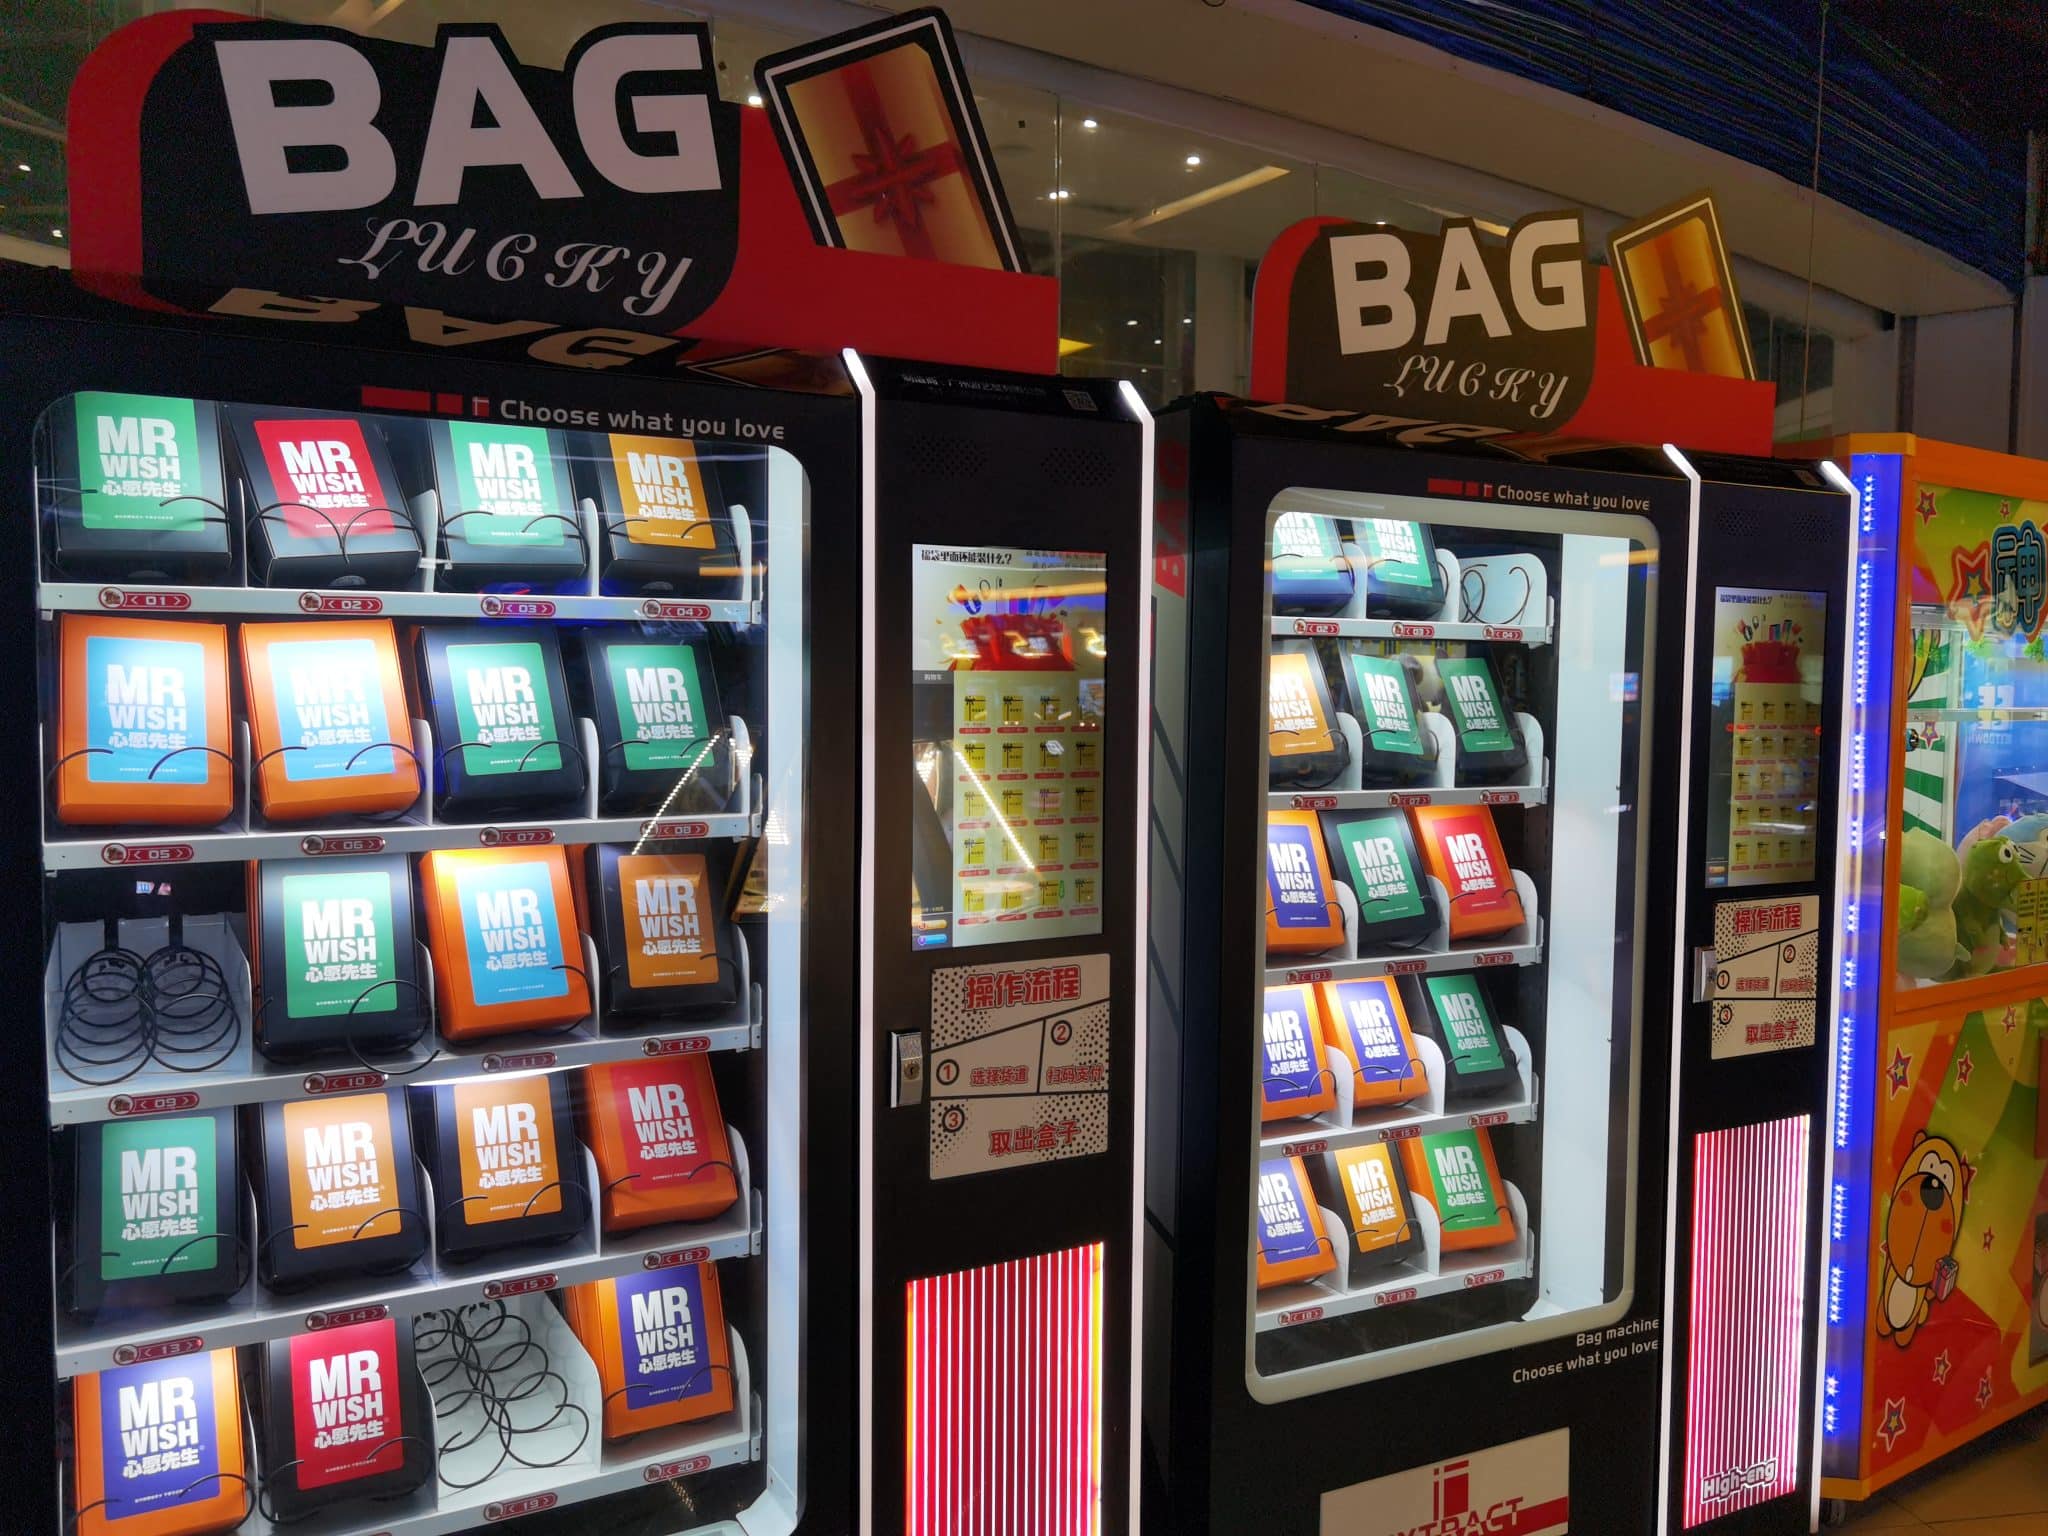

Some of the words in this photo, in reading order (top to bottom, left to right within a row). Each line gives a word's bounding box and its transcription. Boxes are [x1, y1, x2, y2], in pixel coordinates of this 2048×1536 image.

[213, 33, 722, 215] BAG
[338, 218, 690, 316] LUCKY
[1329, 218, 1587, 355] BAG
[1383, 354, 1568, 418] LUCKY
[500, 399, 600, 426] Choose
[608, 409, 673, 432] what
[682, 420, 726, 438] you
[735, 418, 785, 440] love
[97, 416, 177, 456] MR
[99, 455, 181, 479] WISH
[279, 441, 357, 474] MR
[469, 443, 537, 479] MR
[627, 453, 689, 487] MR
[290, 473, 364, 493] WISH
[475, 477, 541, 499] WISH
[633, 485, 692, 506] WISH
[1498, 485, 1549, 502] Choose
[1554, 491, 1589, 505] what
[1594, 496, 1617, 510] you
[1622, 496, 1649, 511] love
[1277, 527, 1320, 544] WISH
[1377, 532, 1417, 552] WISH
[146, 597, 165, 605] 01
[341, 600, 361, 609] 02
[519, 604, 536, 613] 03
[677, 608, 693, 616] 04
[107, 664, 186, 705] MR
[468, 667, 534, 704] MR
[626, 667, 688, 703] MR
[1364, 672, 1403, 703] MR
[1451, 675, 1490, 701] MR
[109, 705, 187, 730] WISH
[296, 705, 369, 728] WISH
[473, 704, 537, 726] WISH
[632, 703, 692, 723] WISH
[1270, 701, 1313, 718] WISH
[1372, 700, 1407, 719] WISH
[1460, 701, 1495, 718] WISH
[517, 833, 535, 841] 07
[1446, 833, 1487, 863] MR
[148, 850, 170, 858] 05
[1269, 843, 1310, 872] MR
[1353, 837, 1400, 869] MR
[1277, 872, 1314, 890] WISH
[1362, 864, 1405, 882] WISH
[1454, 860, 1492, 879] WISH
[476, 888, 542, 929] MR
[635, 878, 697, 915] MR
[302, 899, 375, 939] MR
[640, 914, 700, 938] WISH
[1735, 903, 1802, 936] 操作流程
[304, 938, 376, 963] WISH
[481, 927, 545, 953] WISH
[964, 965, 1081, 1011] 操作流程
[1351, 999, 1392, 1028] MR
[1441, 993, 1480, 1020] MR
[1263, 1009, 1303, 1043] MR
[1357, 1026, 1396, 1046] WISH
[1450, 1019, 1485, 1037] WISH
[1266, 1039, 1307, 1061] WISH
[347, 1077, 365, 1086] 10
[970, 1067, 1029, 1086] 选择货道
[628, 1083, 689, 1123] MR
[472, 1103, 538, 1145] MR
[635, 1120, 693, 1142] WISH
[303, 1122, 375, 1167] MR
[989, 1121, 1080, 1156] 取出盒子
[476, 1141, 541, 1169] WISH
[1434, 1145, 1477, 1177] MR
[121, 1147, 198, 1194] MR
[308, 1159, 378, 1193] WISH
[1347, 1159, 1388, 1194] MR
[1442, 1173, 1481, 1193] WISH
[122, 1189, 198, 1220] WISH
[1260, 1202, 1299, 1224] WISH
[1355, 1190, 1393, 1211] WISH
[522, 1280, 538, 1289] 15
[348, 1311, 365, 1320] 14
[631, 1286, 691, 1333] MR
[635, 1323, 694, 1356] WISH
[1576, 1332, 1602, 1347] Bag
[1606, 1319, 1659, 1340] machine
[162, 1343, 180, 1355] 13
[1513, 1362, 1563, 1383] Choose
[1566, 1352, 1600, 1370] what
[1604, 1347, 1627, 1364] you
[1632, 1340, 1658, 1354] love
[309, 1350, 381, 1402] MR
[119, 1376, 198, 1432] MR
[312, 1392, 383, 1429] WISH
[121, 1418, 199, 1458] WISH
[521, 1499, 538, 1510] 19
